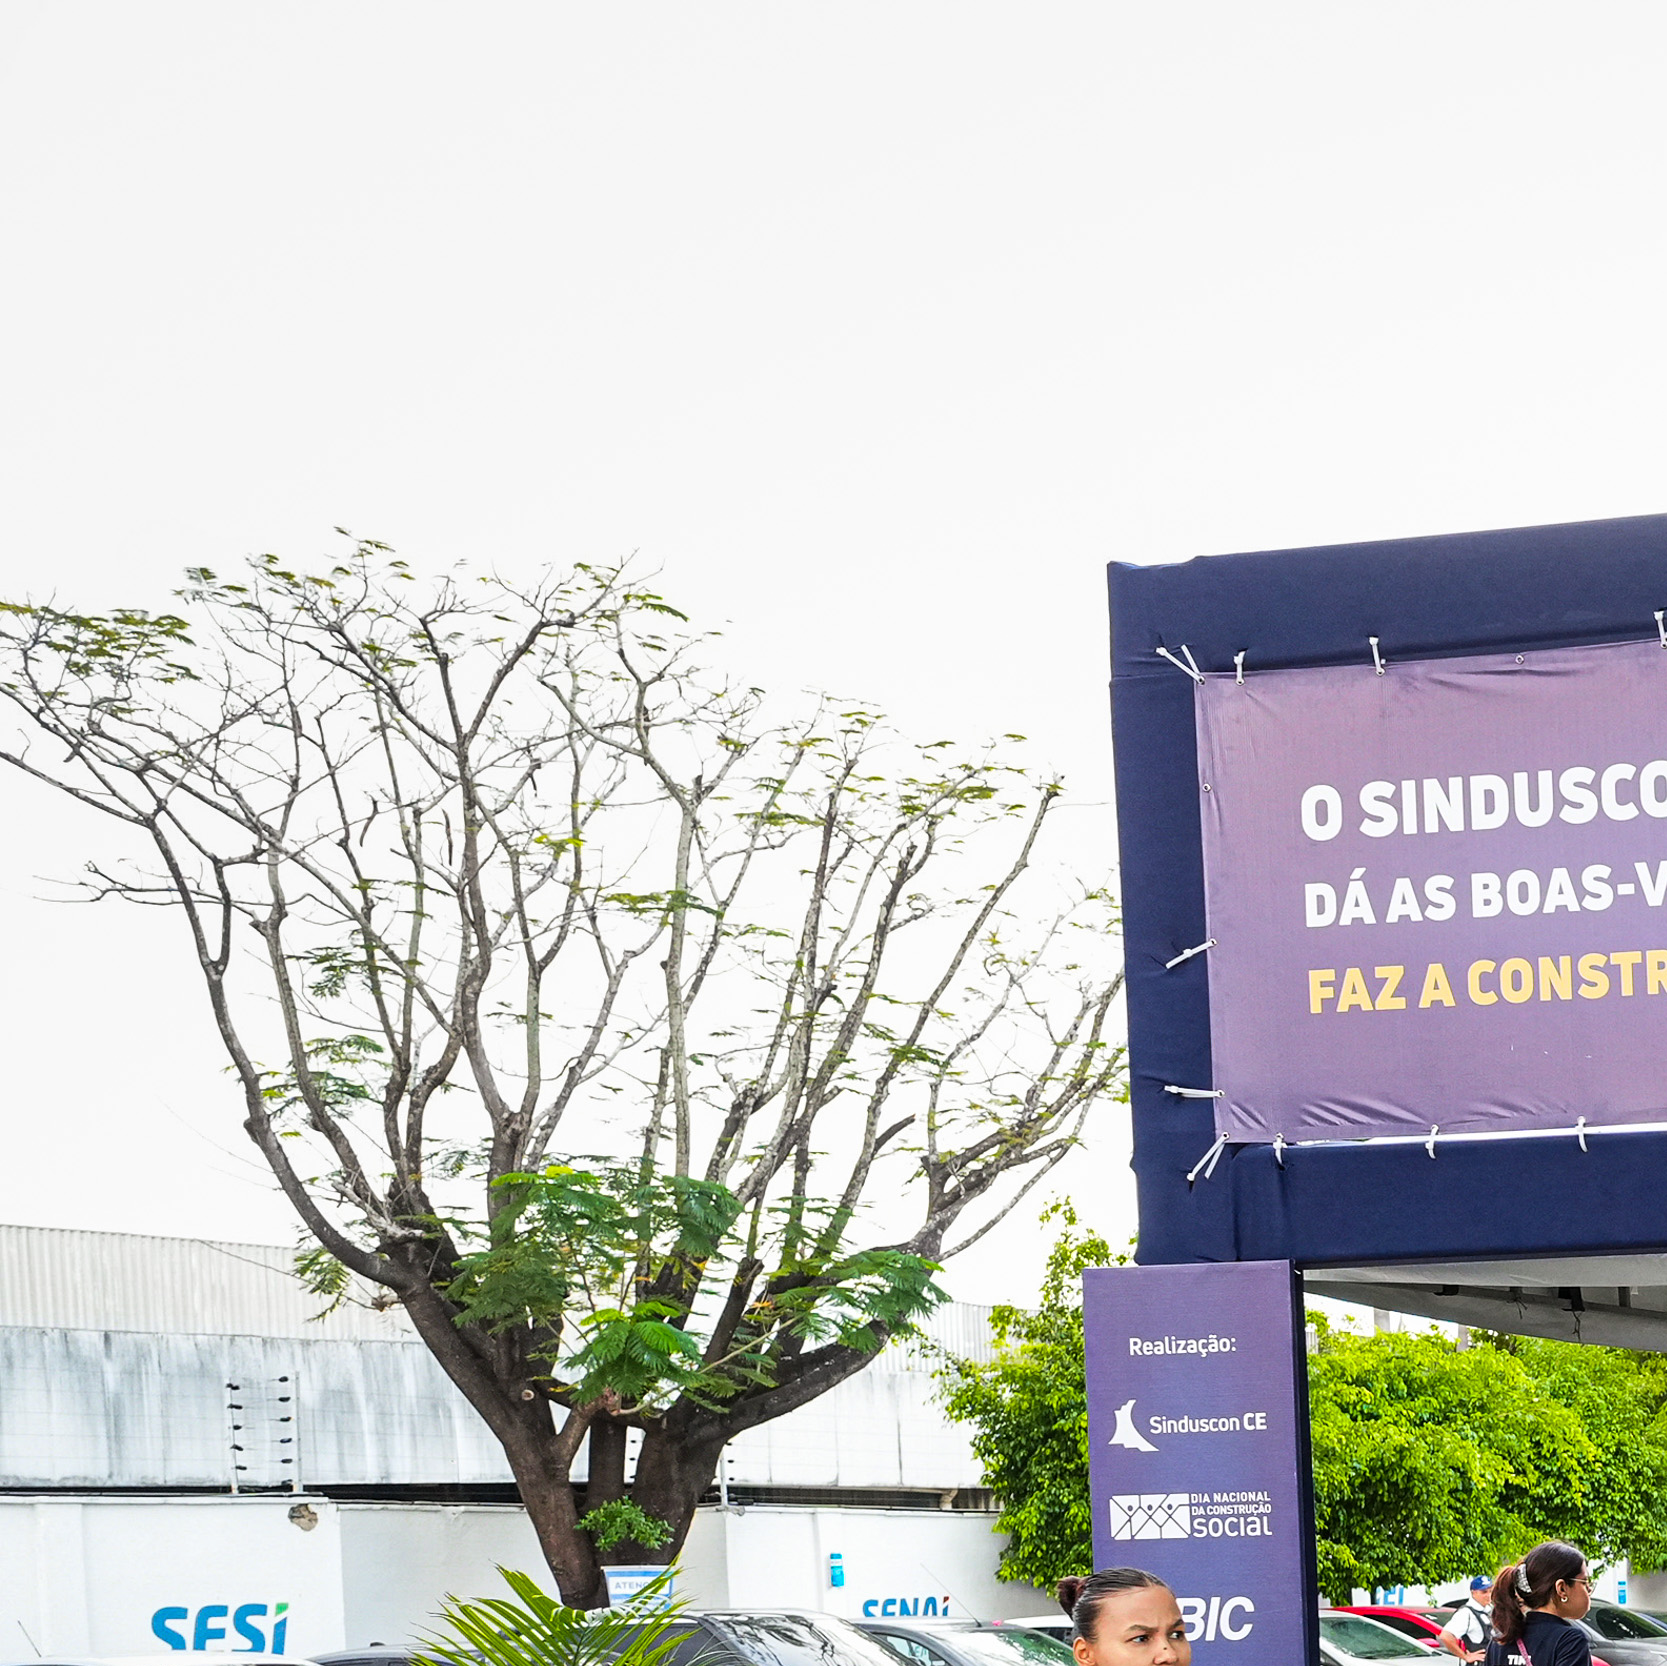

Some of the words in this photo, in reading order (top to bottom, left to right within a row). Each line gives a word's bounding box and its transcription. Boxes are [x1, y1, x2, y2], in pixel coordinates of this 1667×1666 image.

[1301, 784, 1344, 842] O
[1304, 867, 1374, 930] DÁ
[1386, 876, 1456, 923] AS
[1308, 963, 1406, 1015] FAZ
[1419, 962, 1457, 1007] A
[1128, 1334, 1237, 1358] Realização:
[1149, 1413, 1240, 1435] Sinduscon
[1242, 1412, 1268, 1431] CE
[1191, 1493, 1211, 1504] DIA
[1213, 1491, 1271, 1503] NACIONAL
[1191, 1505, 1206, 1516] DA
[1206, 1502, 1272, 1516] CONSTRUÇÃO
[1176, 1596, 1255, 1641] BIC
